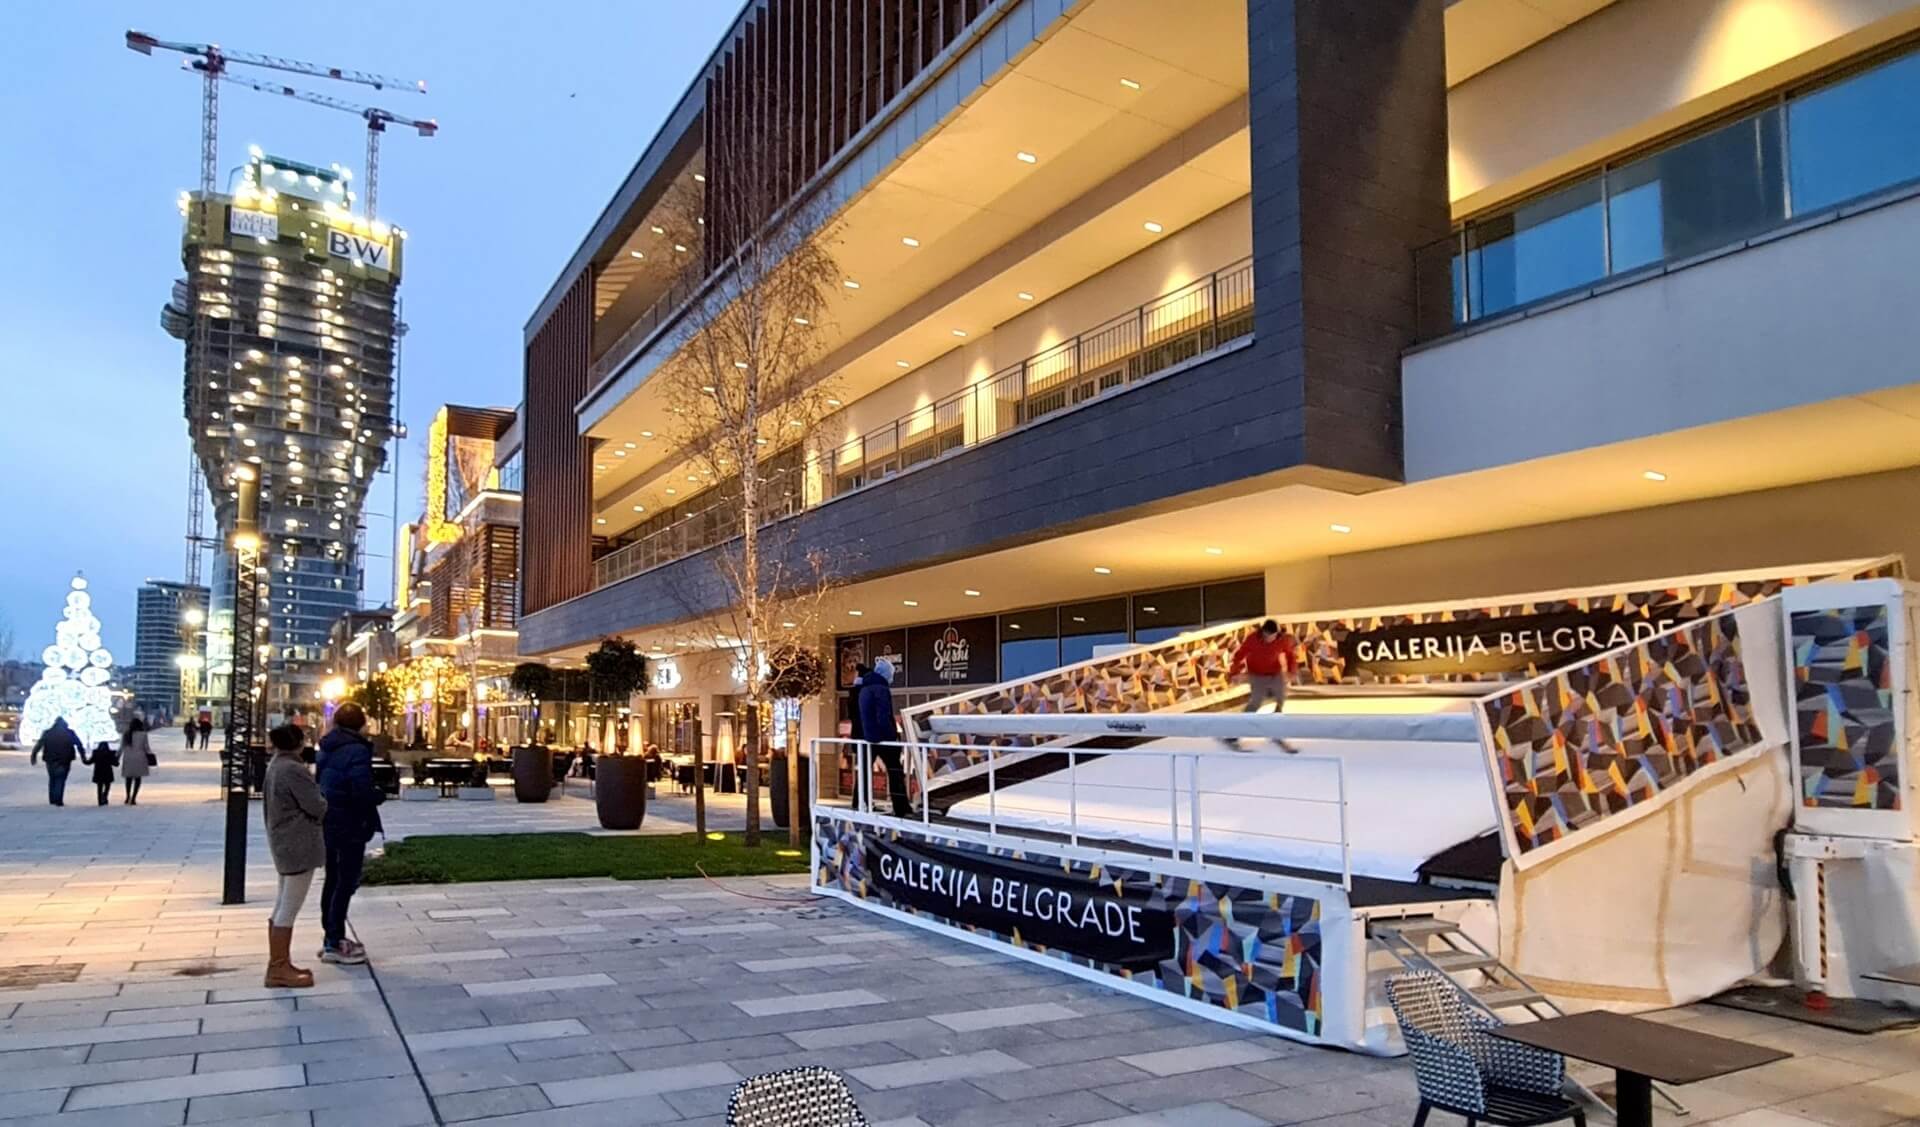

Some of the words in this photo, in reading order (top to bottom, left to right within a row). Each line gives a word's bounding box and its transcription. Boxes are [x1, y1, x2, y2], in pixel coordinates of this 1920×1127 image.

[330, 231, 383, 264] BW
[933, 638, 969, 671] Sushi
[1357, 635, 1489, 663] GALERIJA
[880, 854, 981, 907] GALERIJA
[991, 878, 1145, 943] BELGRADE
